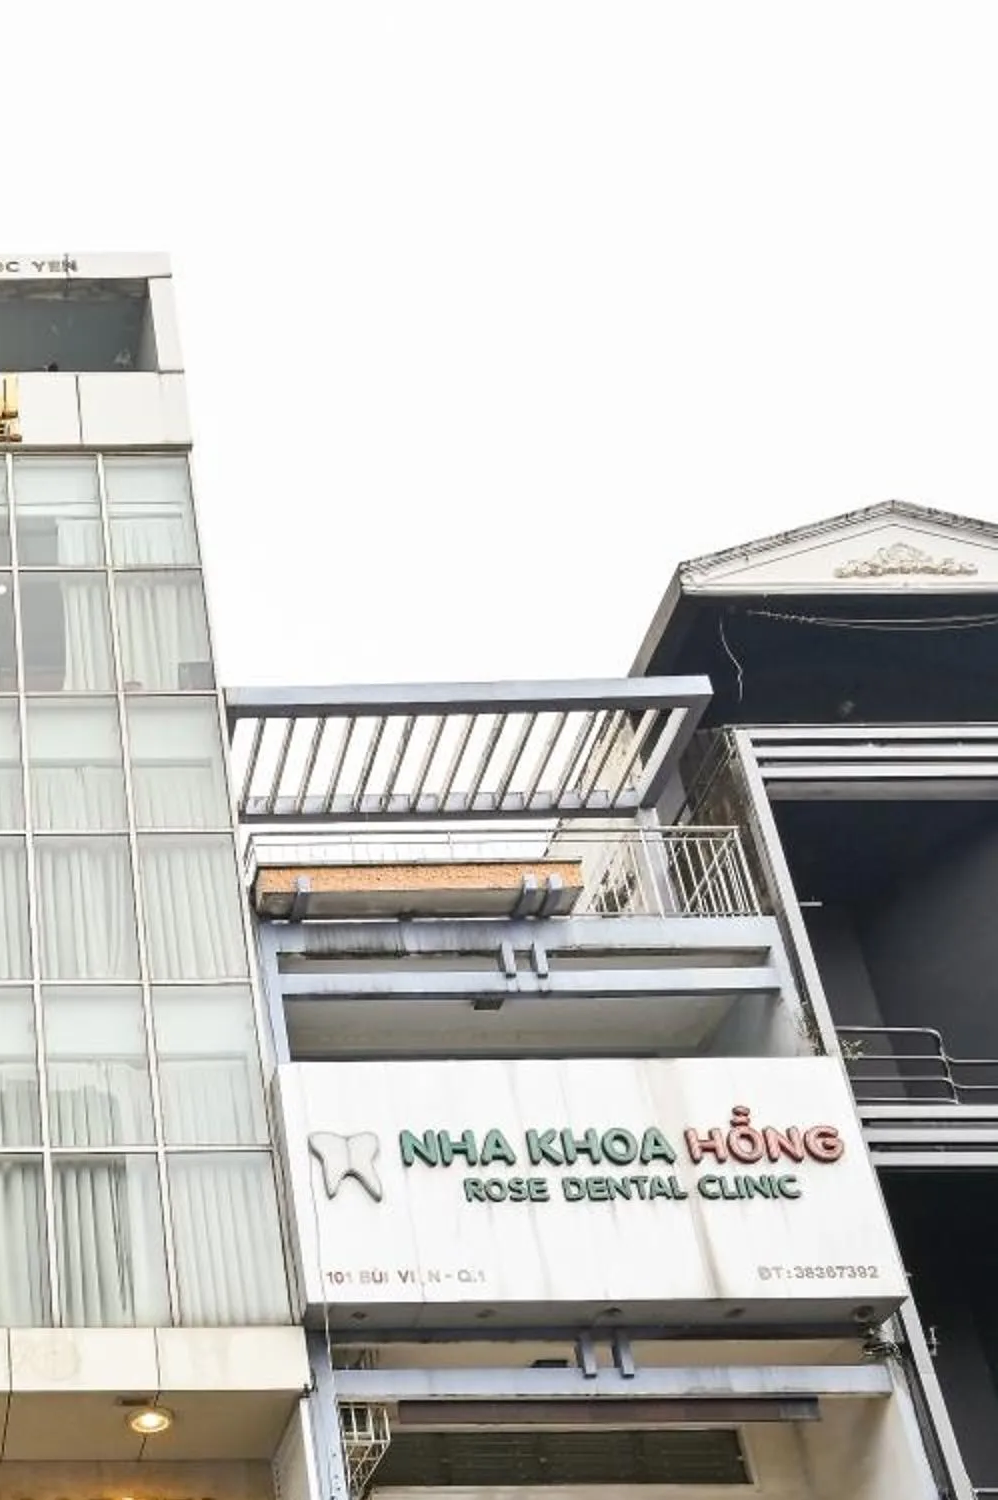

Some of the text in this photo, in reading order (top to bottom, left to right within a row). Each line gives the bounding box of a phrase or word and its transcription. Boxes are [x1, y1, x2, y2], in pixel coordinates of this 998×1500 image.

[400, 1128, 516, 1166] NHA
[525, 1128, 676, 1166] KHOA
[464, 1173, 802, 1203] ROSE DENTAL CLINIC
[326, 1270, 353, 1285] 101
